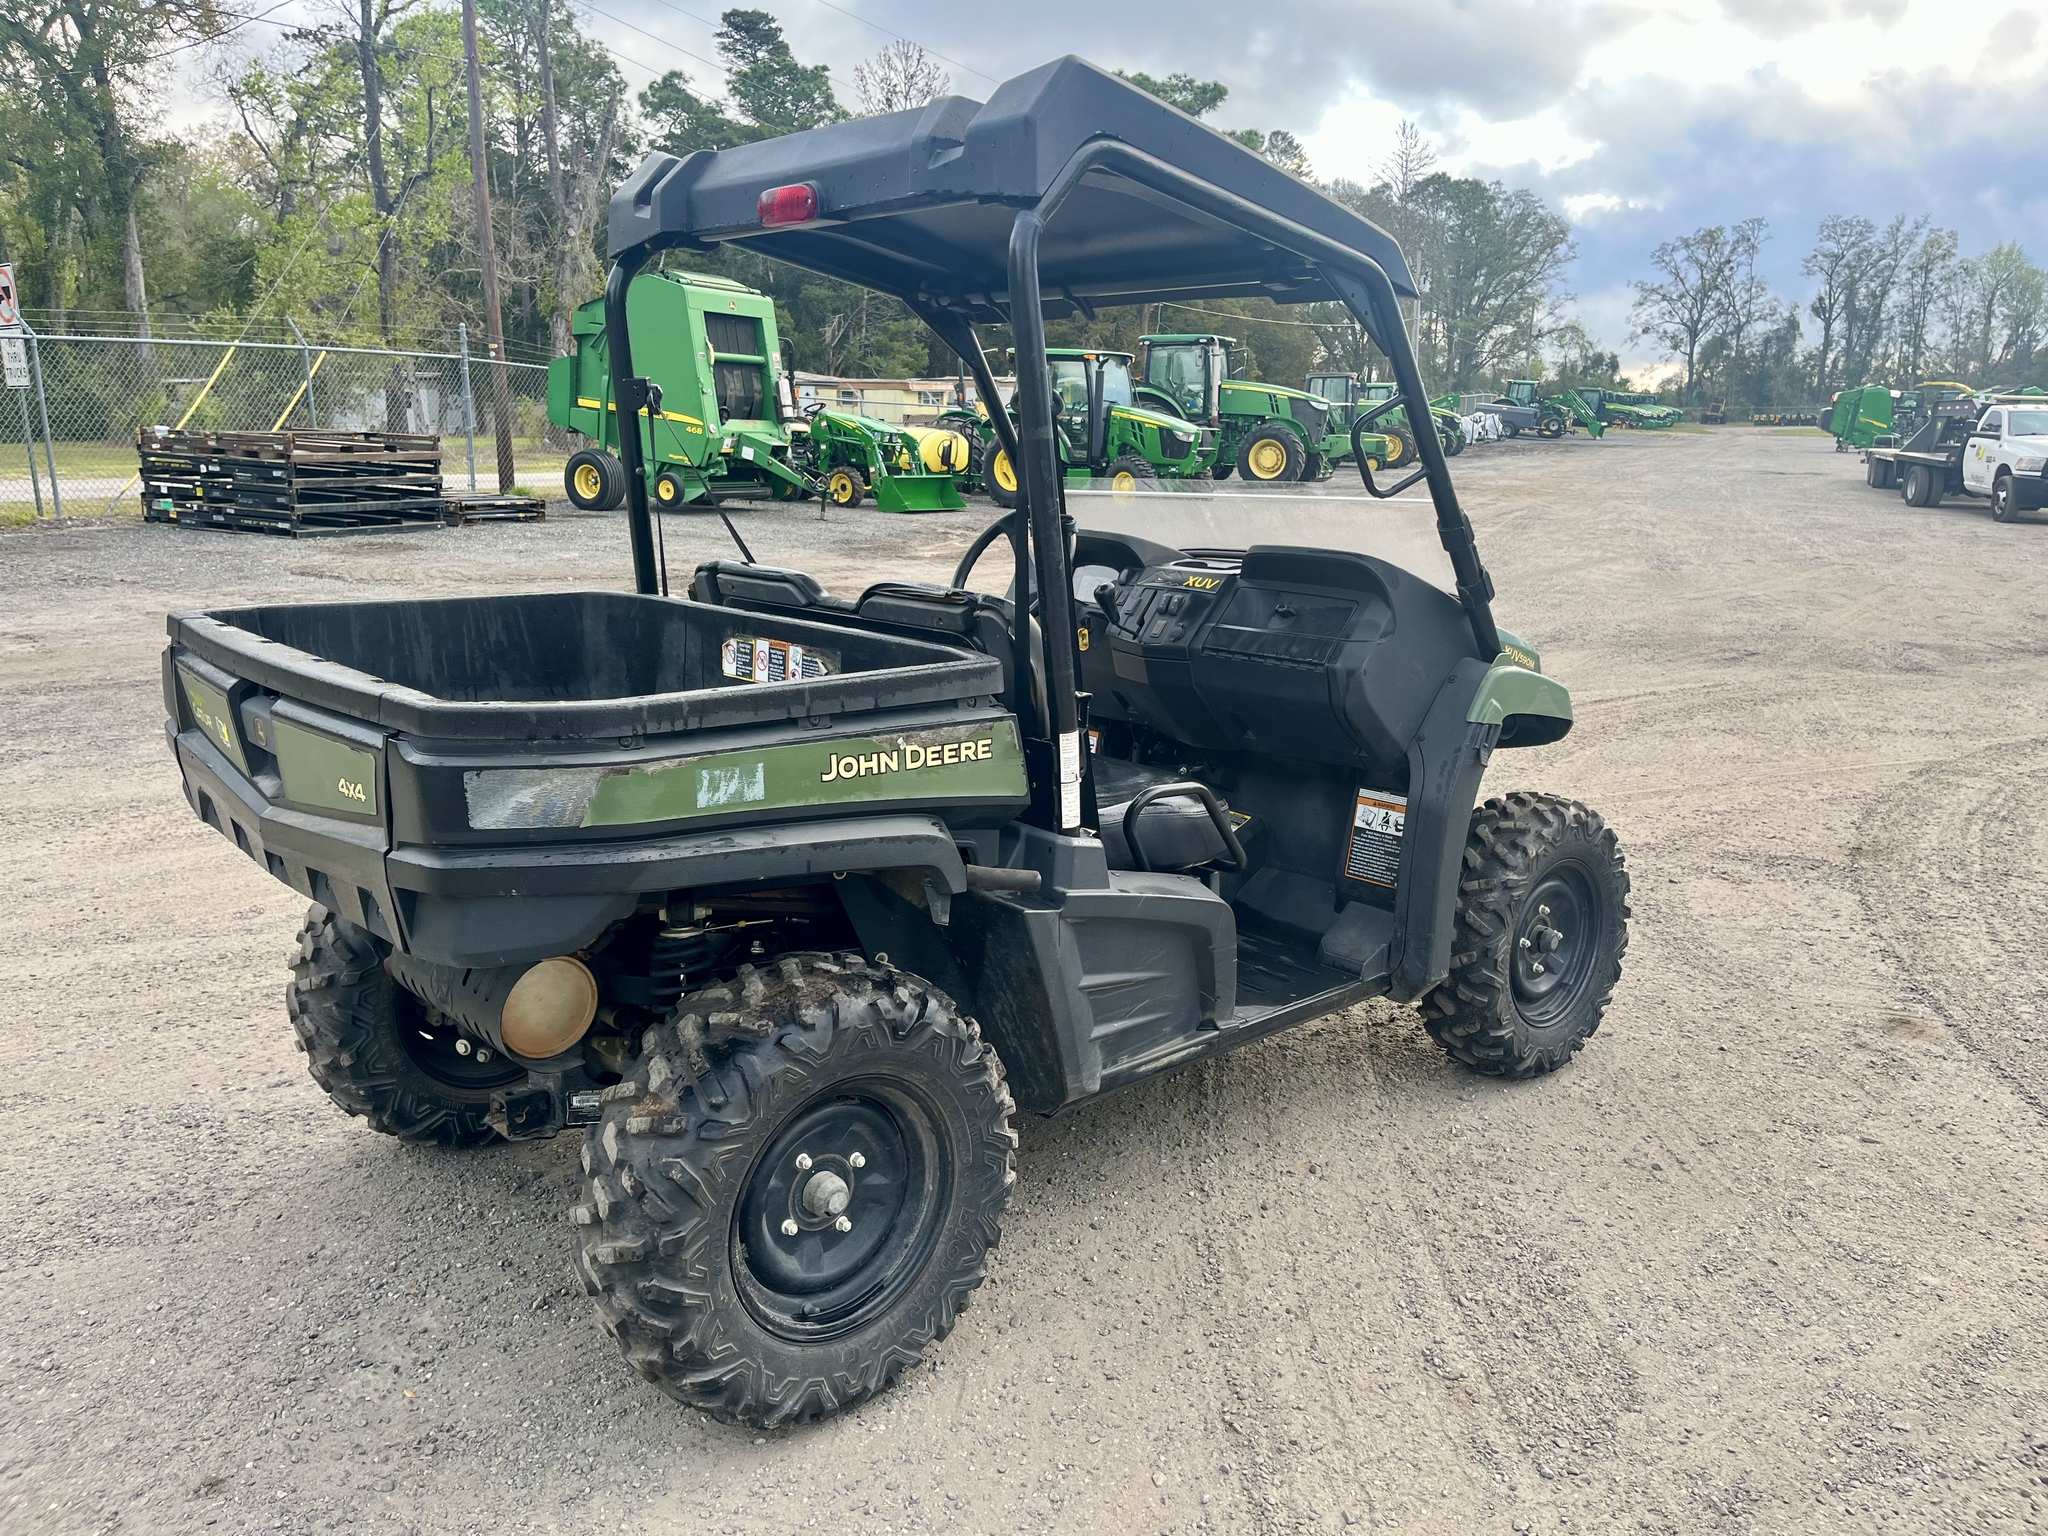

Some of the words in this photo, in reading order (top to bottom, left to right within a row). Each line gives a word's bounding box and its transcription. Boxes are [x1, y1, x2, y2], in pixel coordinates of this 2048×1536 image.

[685, 425, 703, 435] 468
[1183, 575, 1220, 589] XUV
[821, 751, 899, 782] JOHN
[905, 738, 992, 770] DEERE
